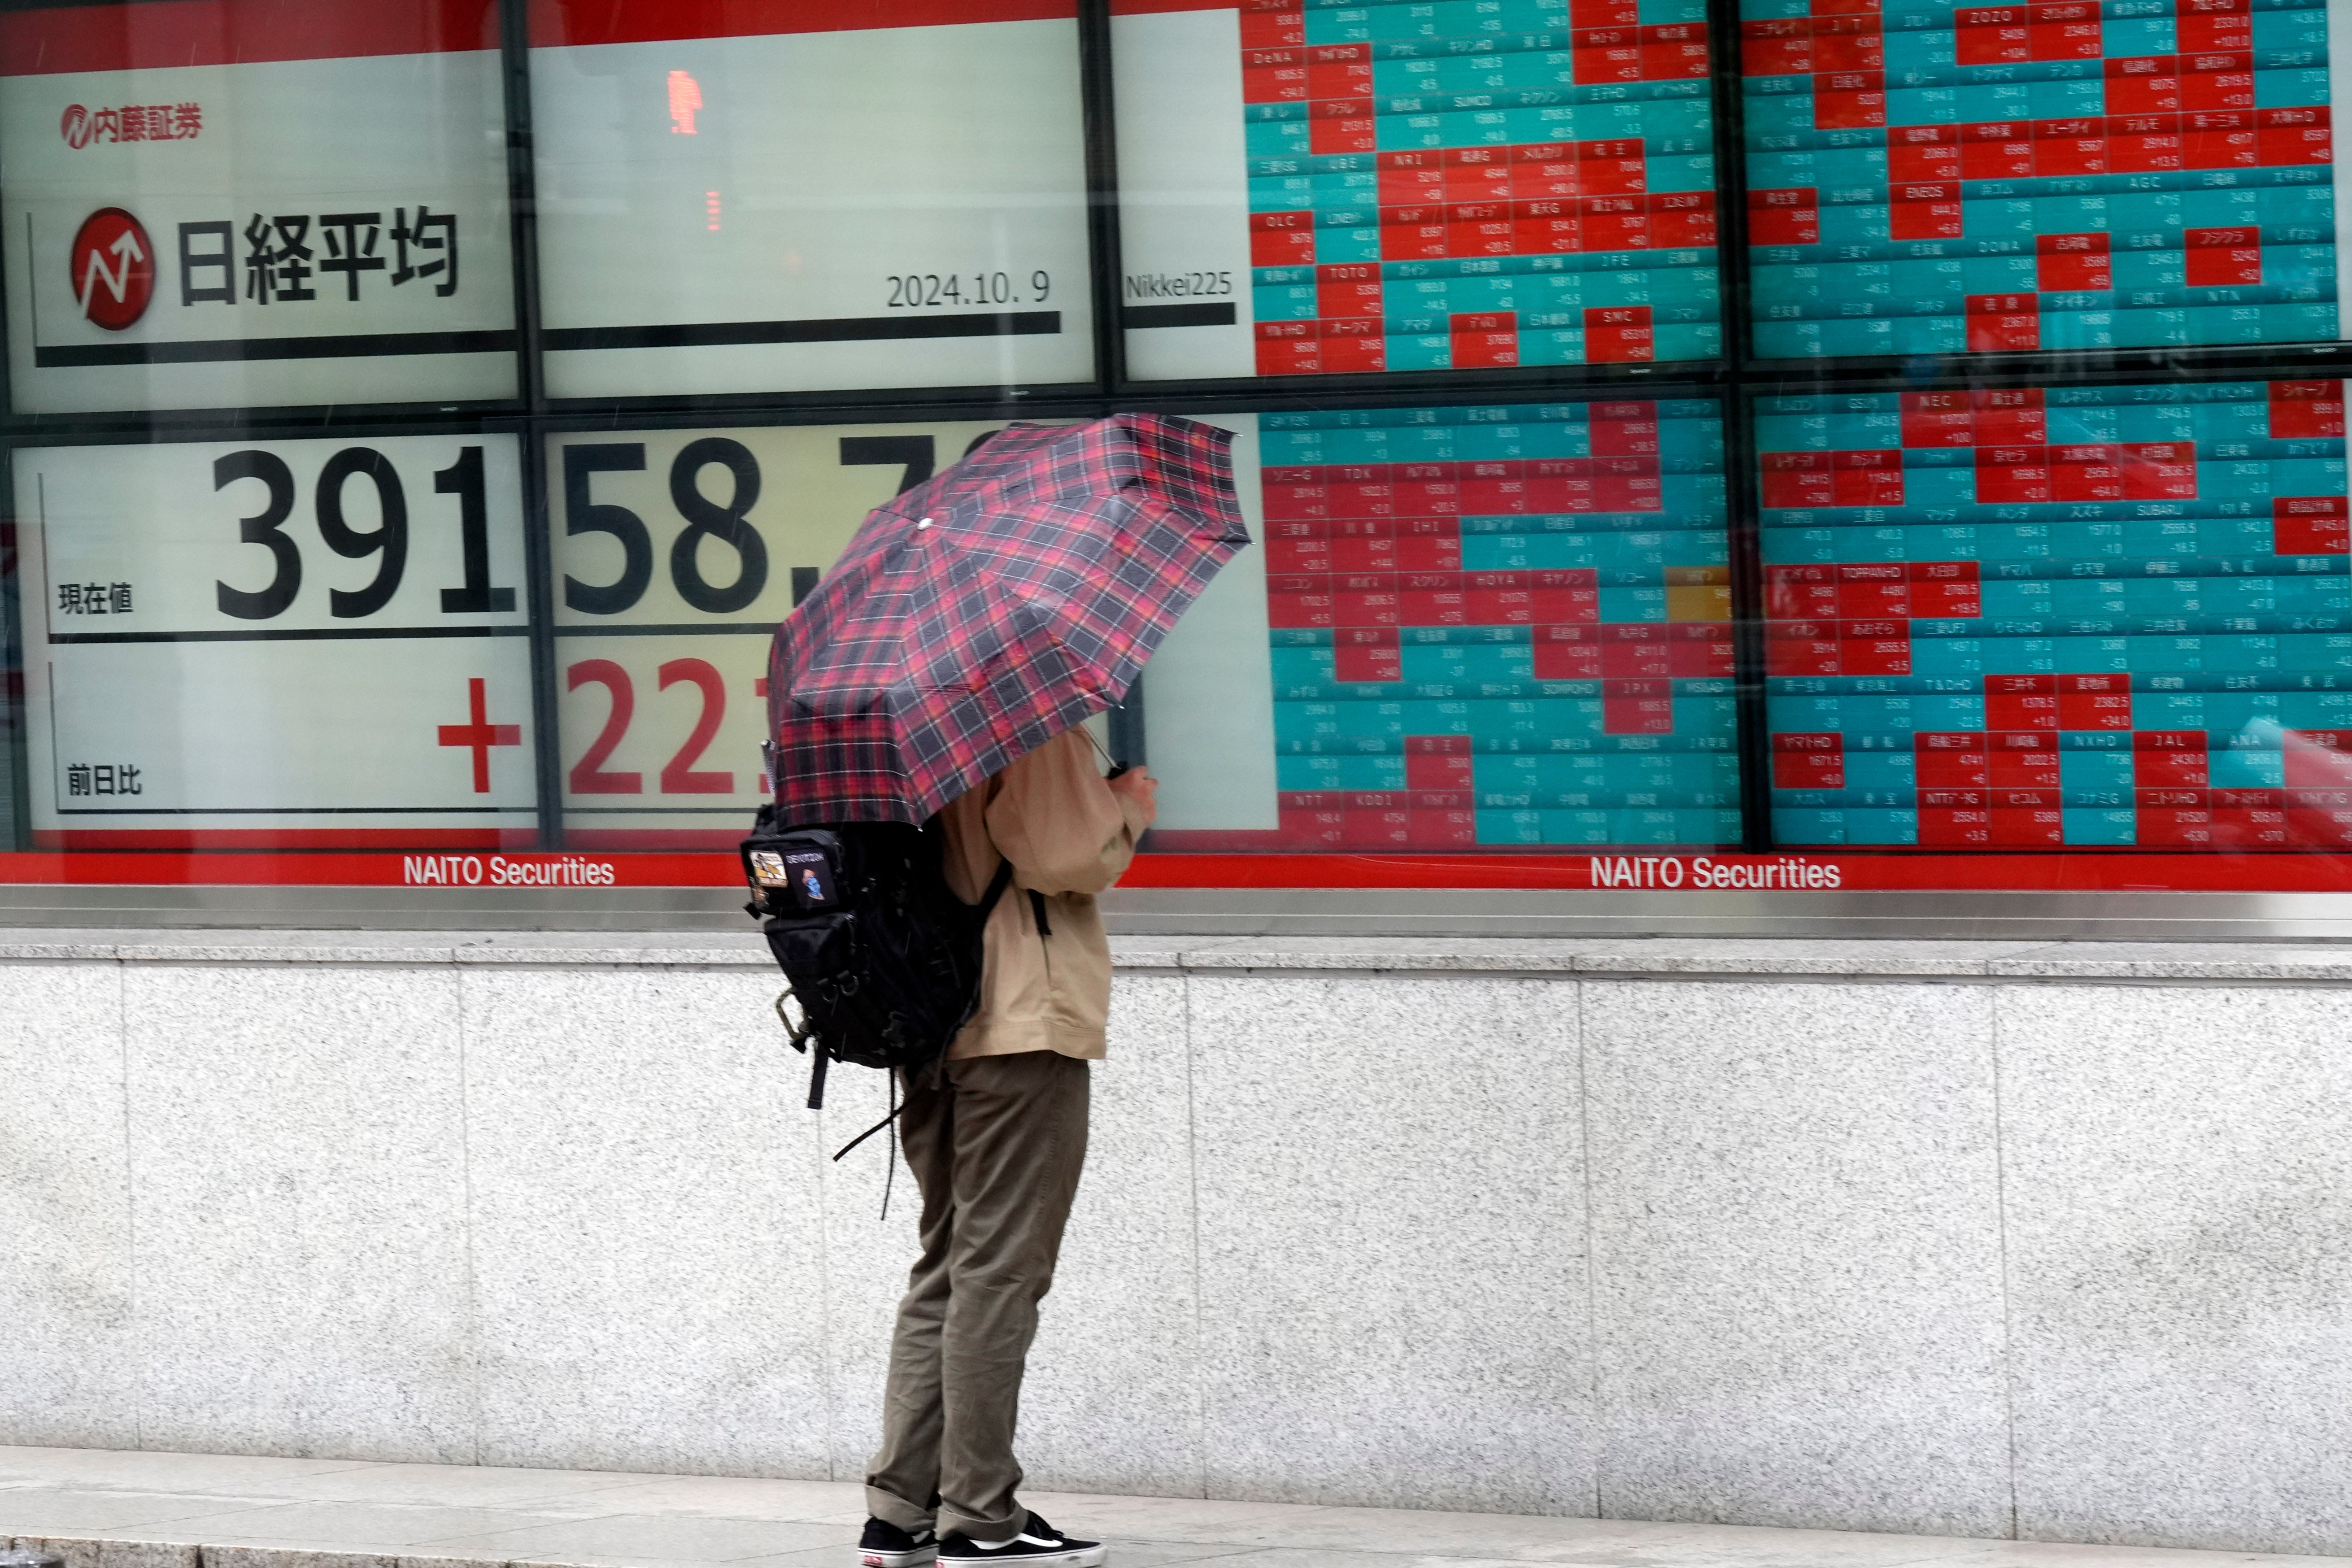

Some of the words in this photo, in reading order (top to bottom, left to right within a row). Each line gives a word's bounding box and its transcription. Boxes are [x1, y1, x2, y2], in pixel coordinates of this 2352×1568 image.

[93, 102, 203, 144] 内藤証券
[179, 205, 457, 306] 日経平均
[1127, 272, 1232, 298] Nikkei225
[59, 583, 134, 614] 現在値
[567, 657, 769, 794] 22
[68, 763, 142, 796] 前日比
[404, 856, 483, 884] NAITO
[490, 856, 615, 885] Securities
[1591, 856, 1684, 888] NAITO
[1693, 857, 1841, 888] Securities
